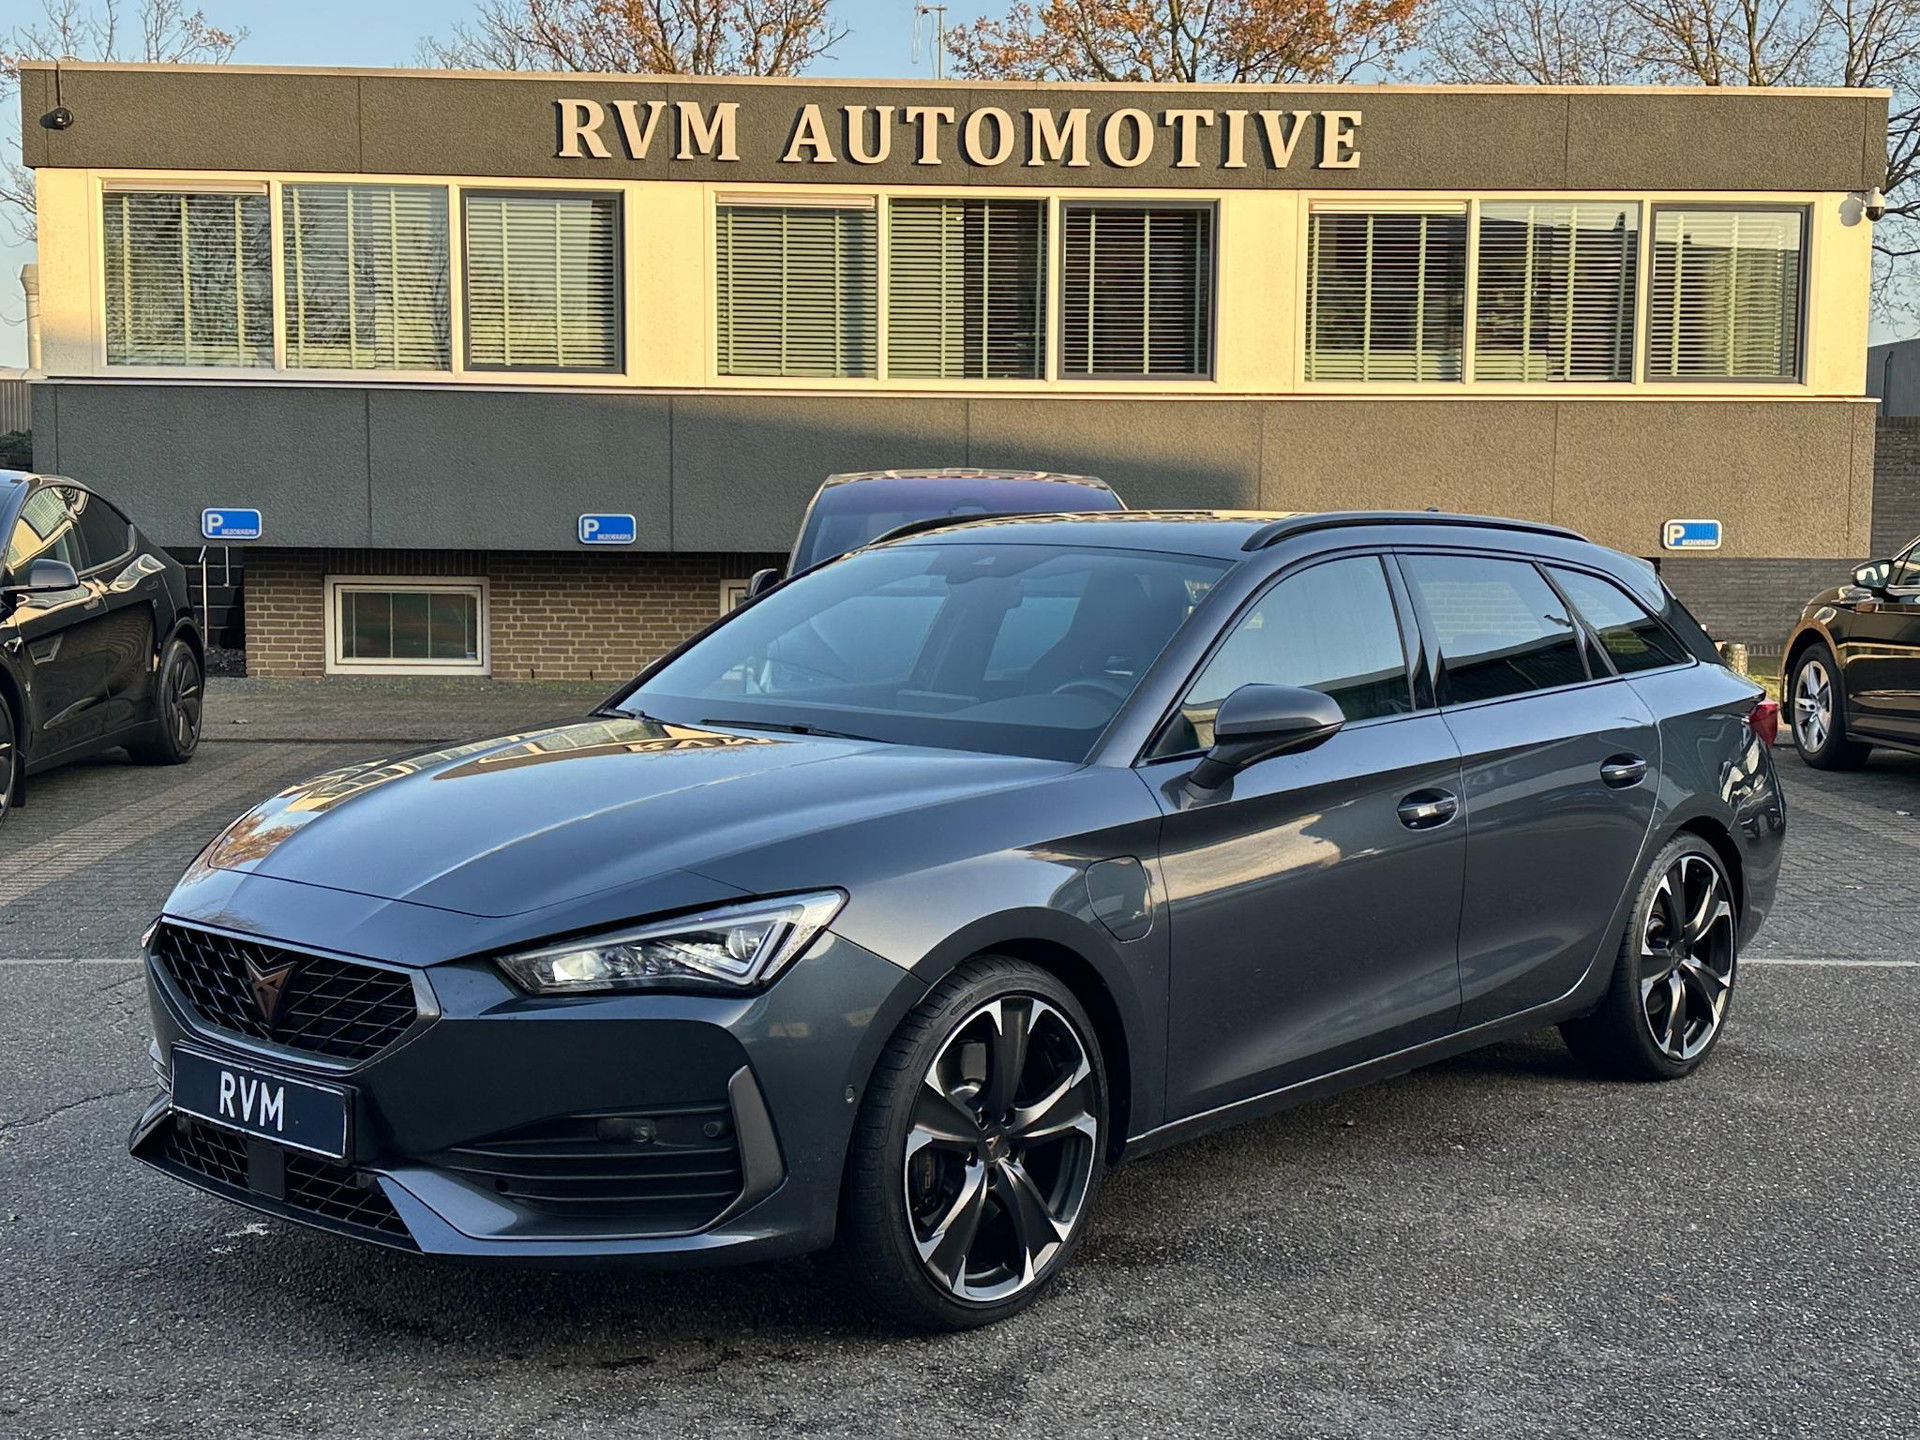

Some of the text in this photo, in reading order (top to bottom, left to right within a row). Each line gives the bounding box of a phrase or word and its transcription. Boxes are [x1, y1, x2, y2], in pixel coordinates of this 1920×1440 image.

[557, 98, 1362, 169] RVM AUTOMOTIVE
[207, 513, 223, 533] P
[583, 519, 599, 539] P
[1669, 525, 1685, 545] P
[219, 1071, 284, 1132] RVM
